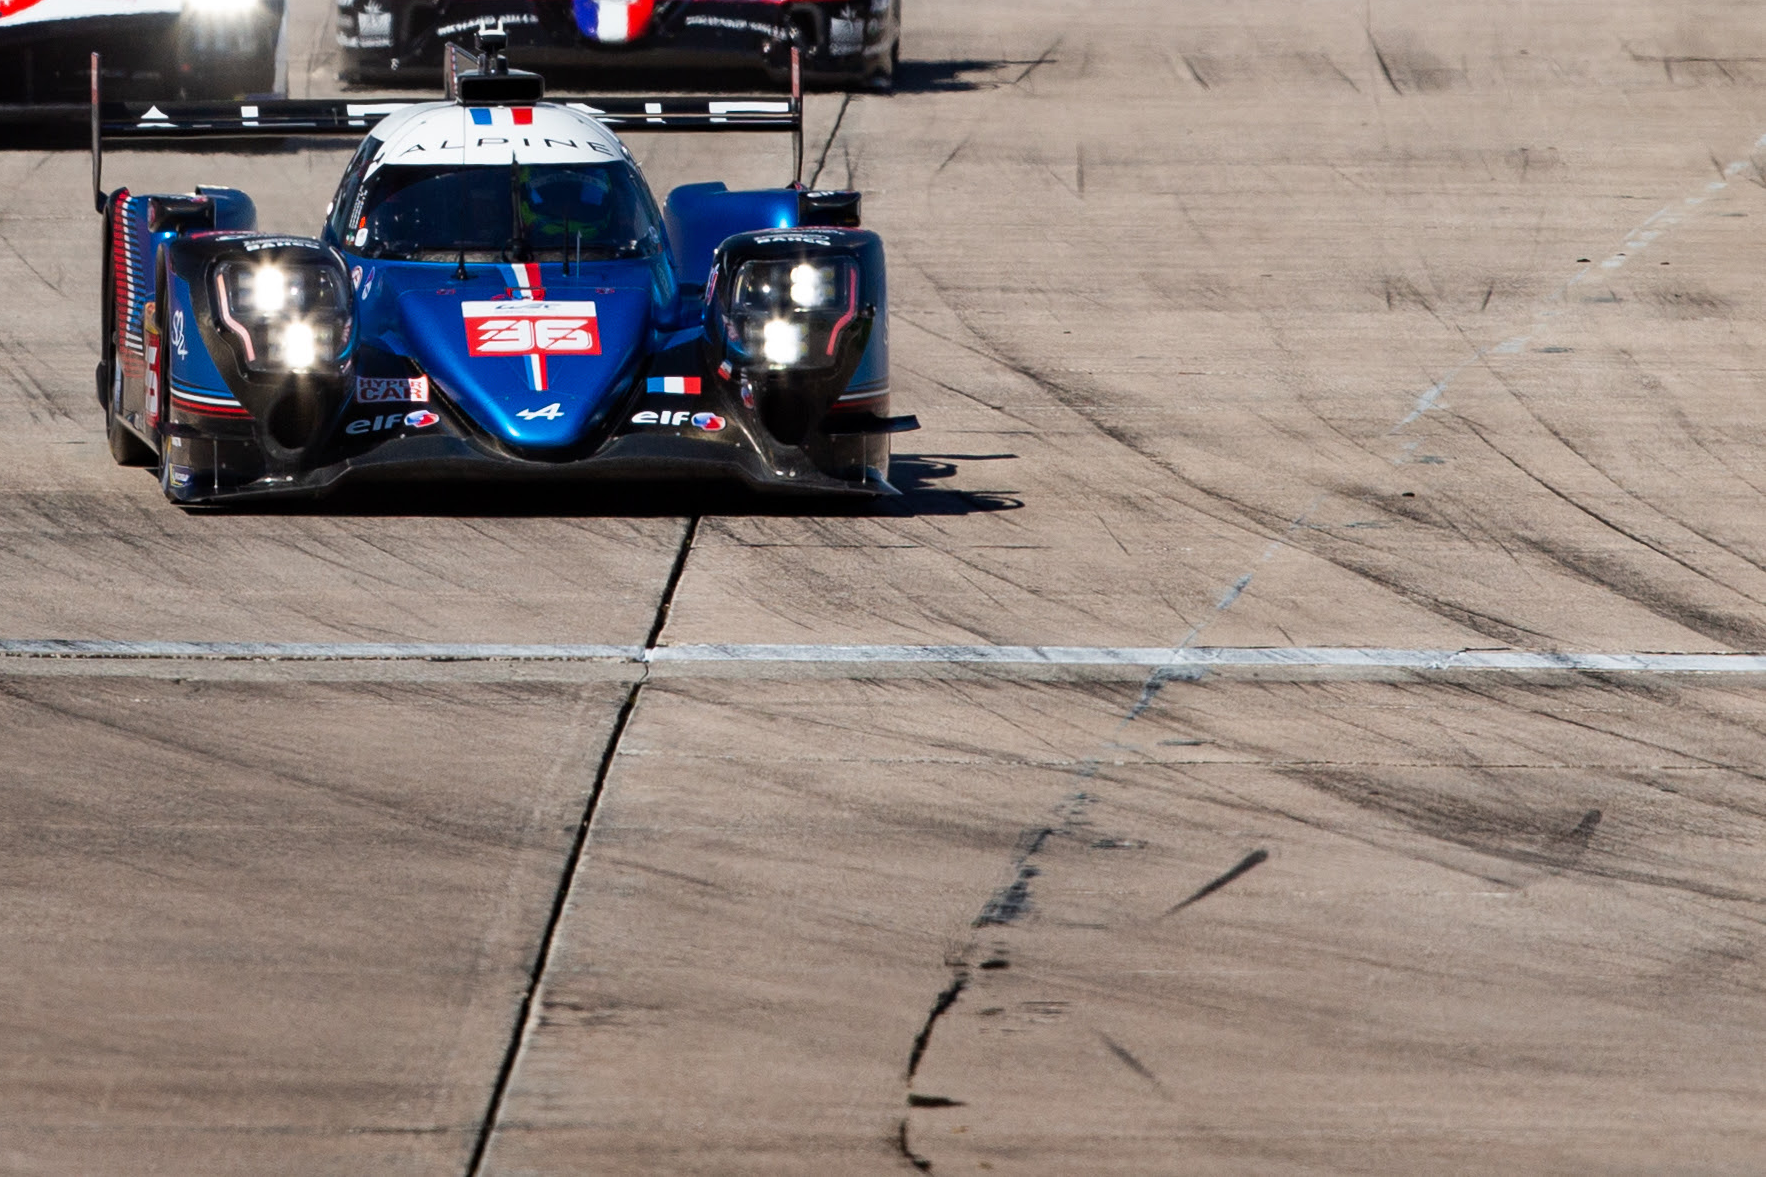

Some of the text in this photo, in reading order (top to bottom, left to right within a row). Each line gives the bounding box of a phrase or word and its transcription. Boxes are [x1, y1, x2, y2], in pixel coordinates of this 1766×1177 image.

[398, 136, 616, 158] ALPINE
[476, 319, 594, 353] 36
[359, 380, 422, 389] HYPER
[360, 387, 423, 401] CAR
[345, 413, 404, 435] elf
[631, 410, 691, 426] elf
